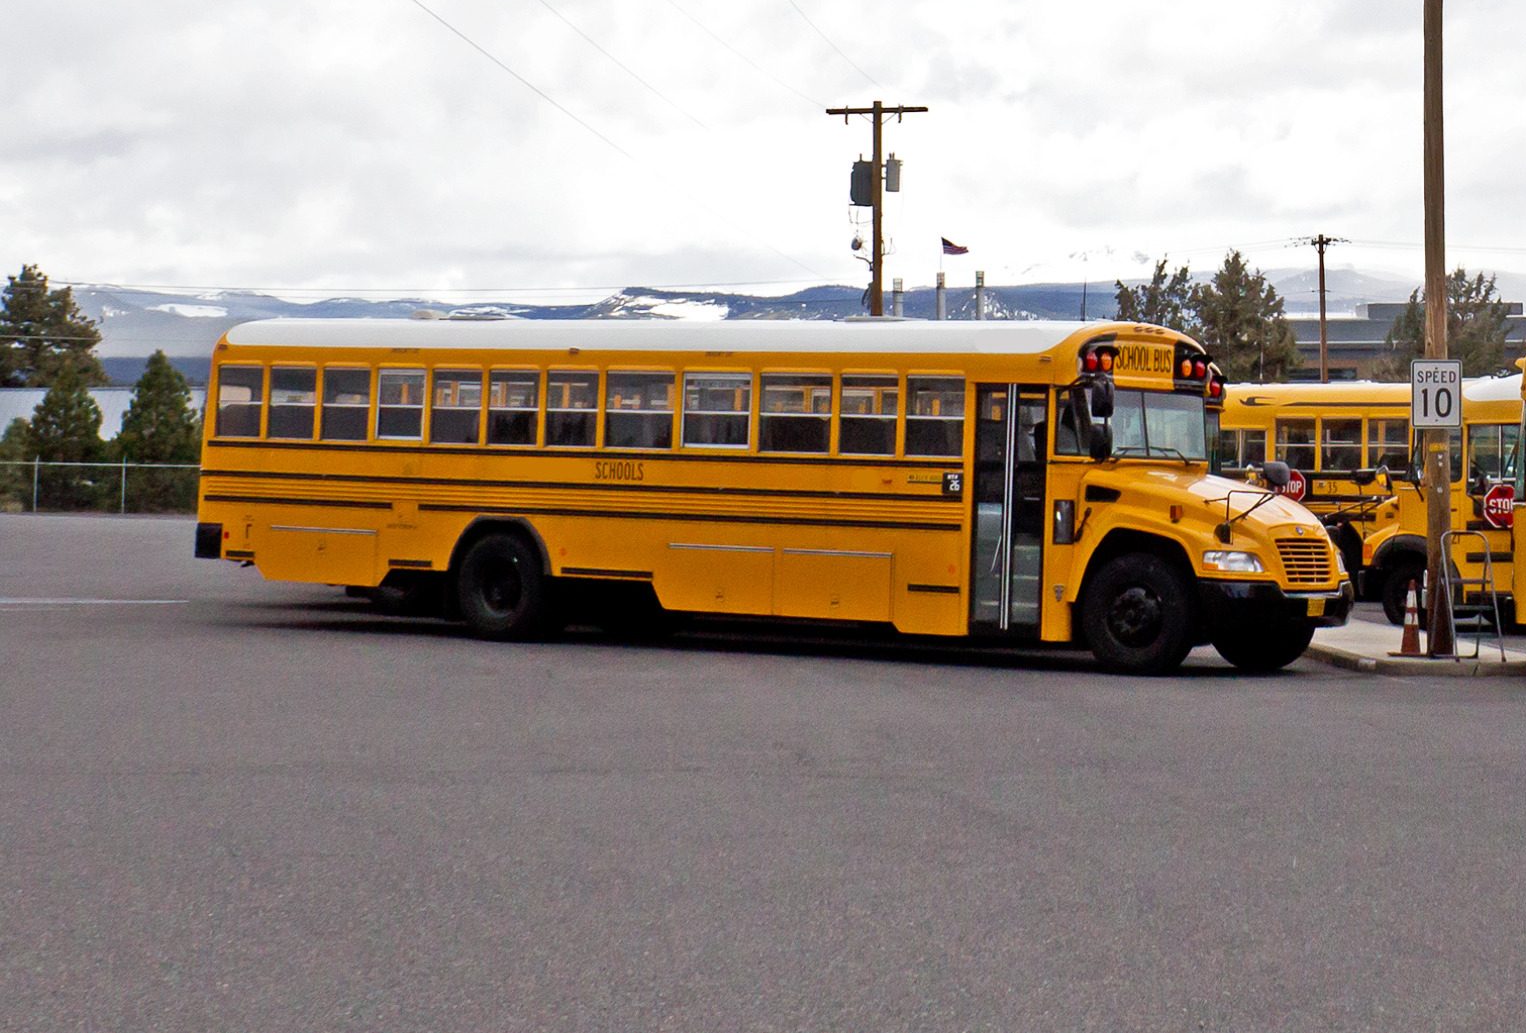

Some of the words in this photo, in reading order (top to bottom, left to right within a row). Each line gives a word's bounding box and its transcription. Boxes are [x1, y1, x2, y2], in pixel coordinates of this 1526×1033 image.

[1116, 345, 1151, 372] SCHOOL
[1153, 348, 1172, 373] BUS
[1417, 370, 1456, 383] SPEED
[1421, 387, 1452, 417] 10
[595, 461, 644, 481] SCHOOLS
[1327, 481, 1338, 494] 35
